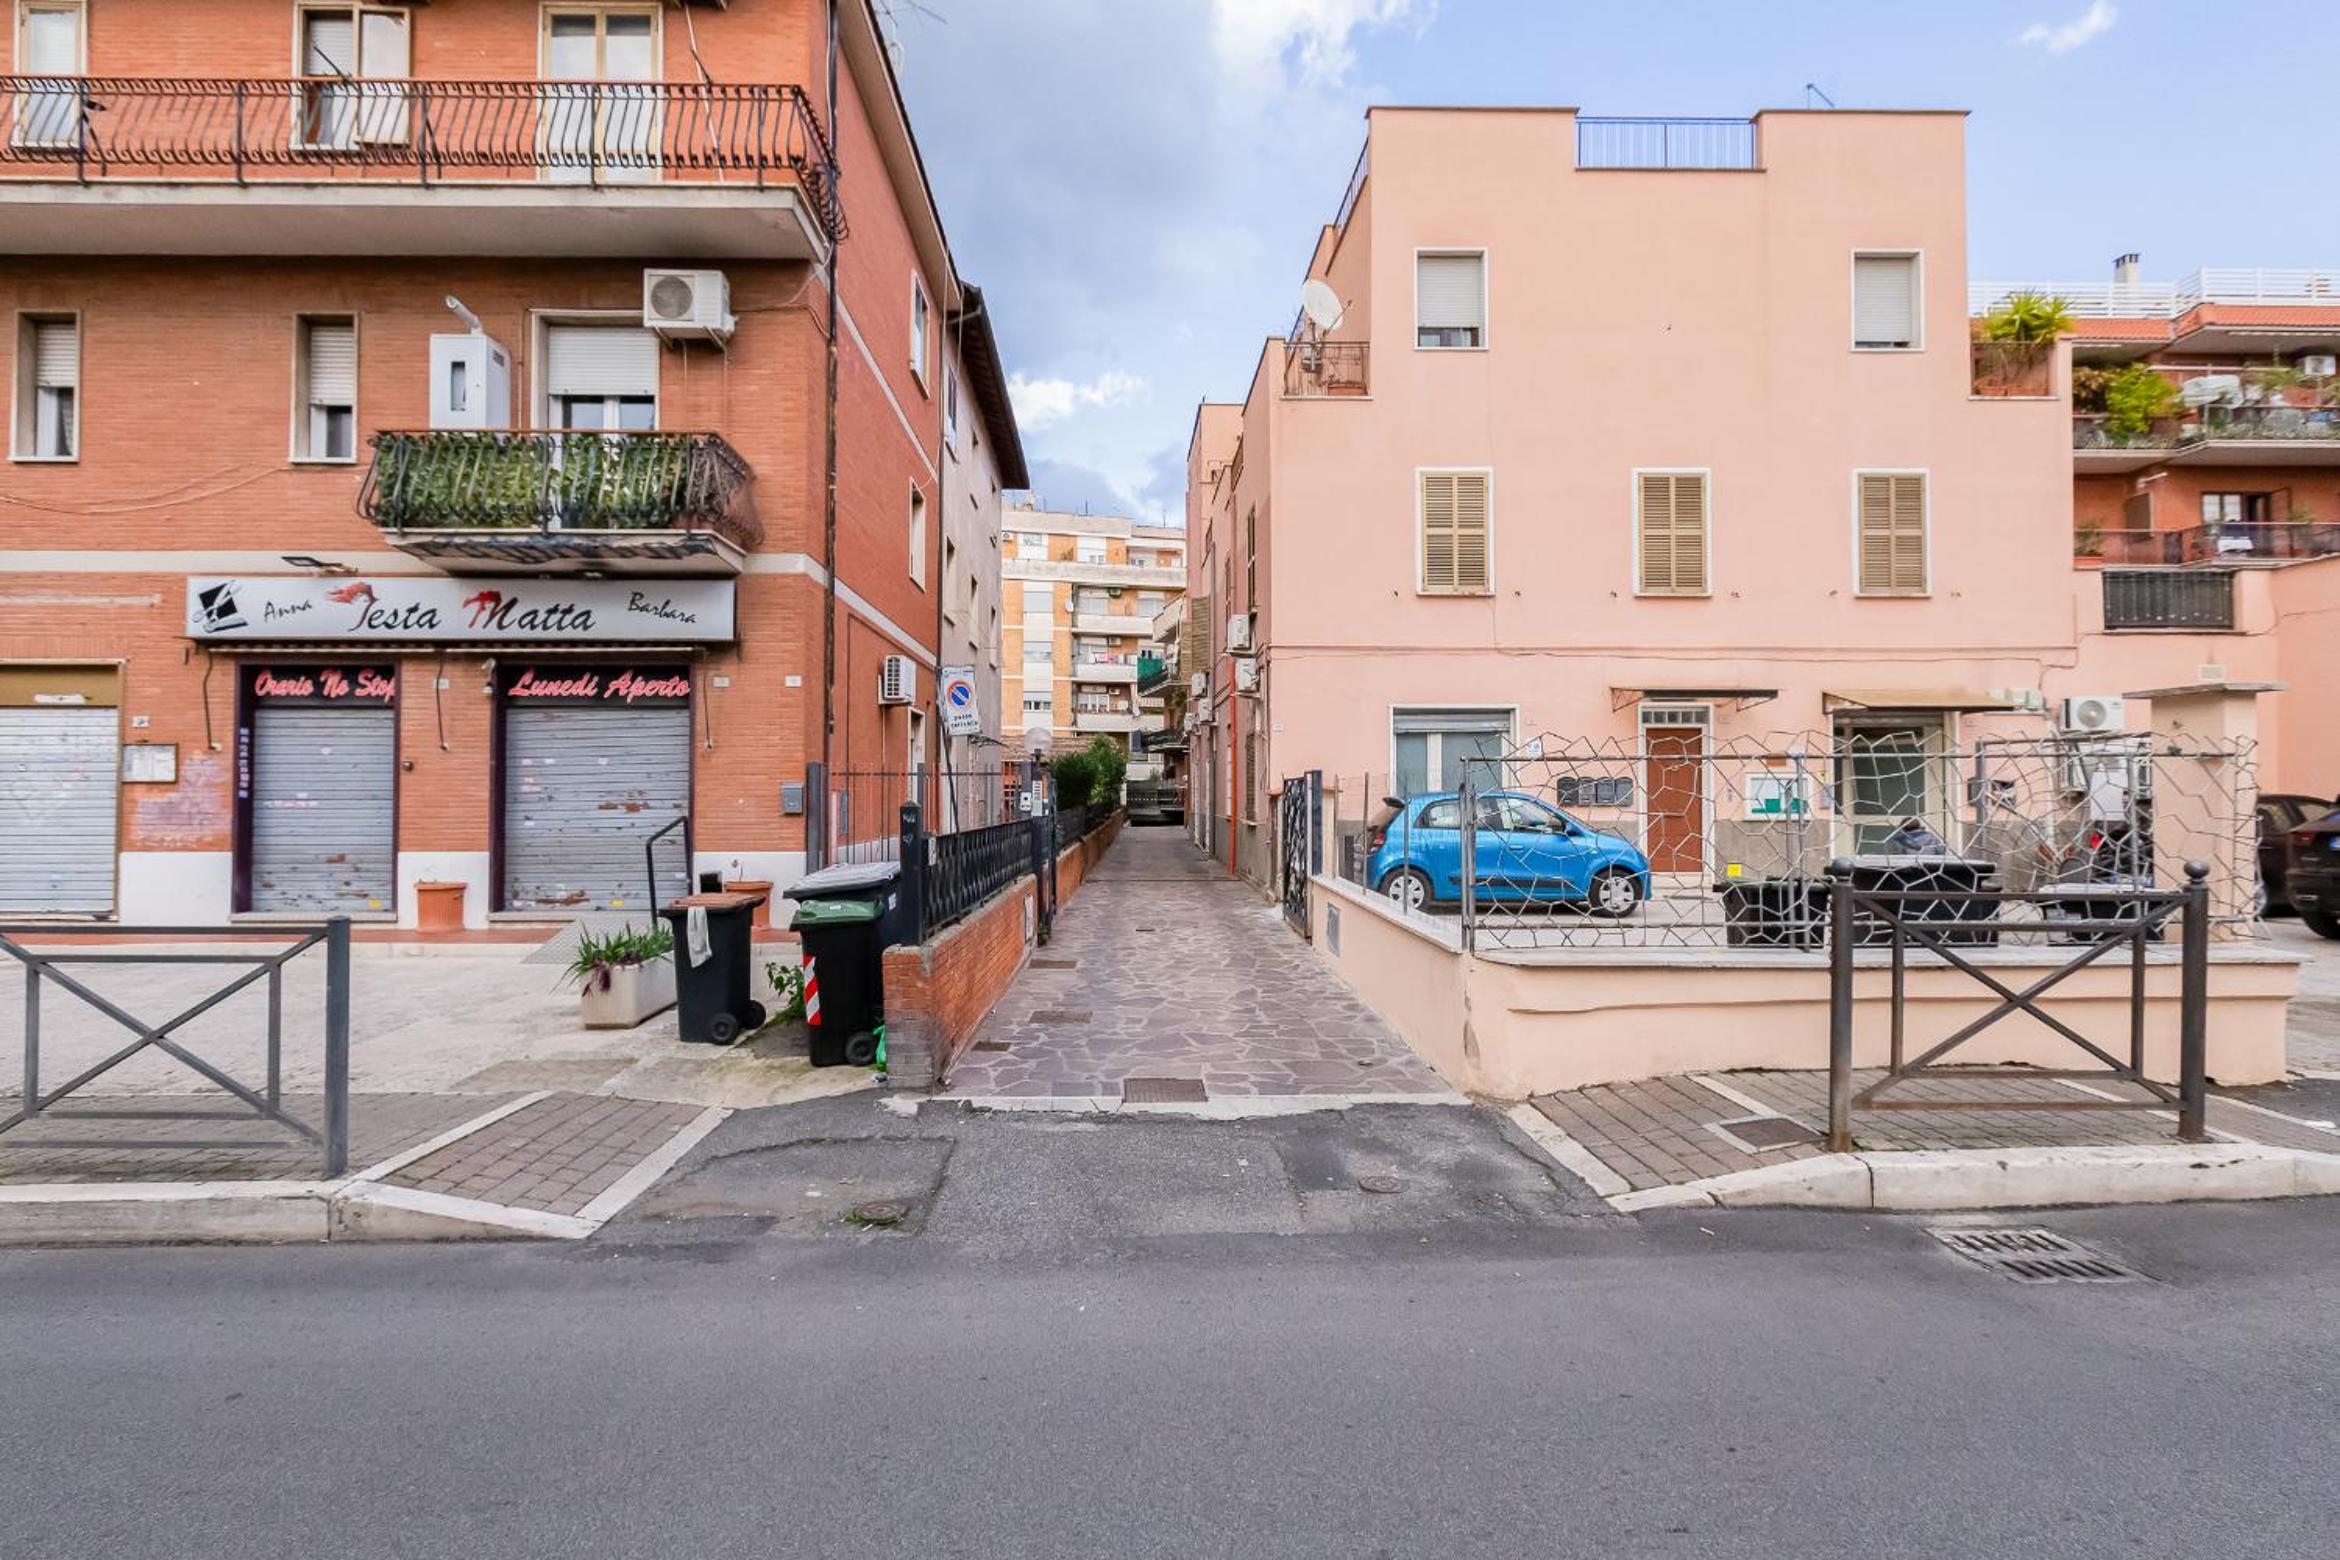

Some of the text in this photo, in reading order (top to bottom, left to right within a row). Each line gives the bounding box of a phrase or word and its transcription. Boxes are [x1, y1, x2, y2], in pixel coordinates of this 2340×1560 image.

[264, 601, 313, 623] Anna
[326, 581, 597, 633] Testa Matta
[627, 591, 697, 625] Barbara
[255, 669, 315, 697] Orario
[320, 669, 350, 698] No
[603, 669, 692, 704] Aperto
